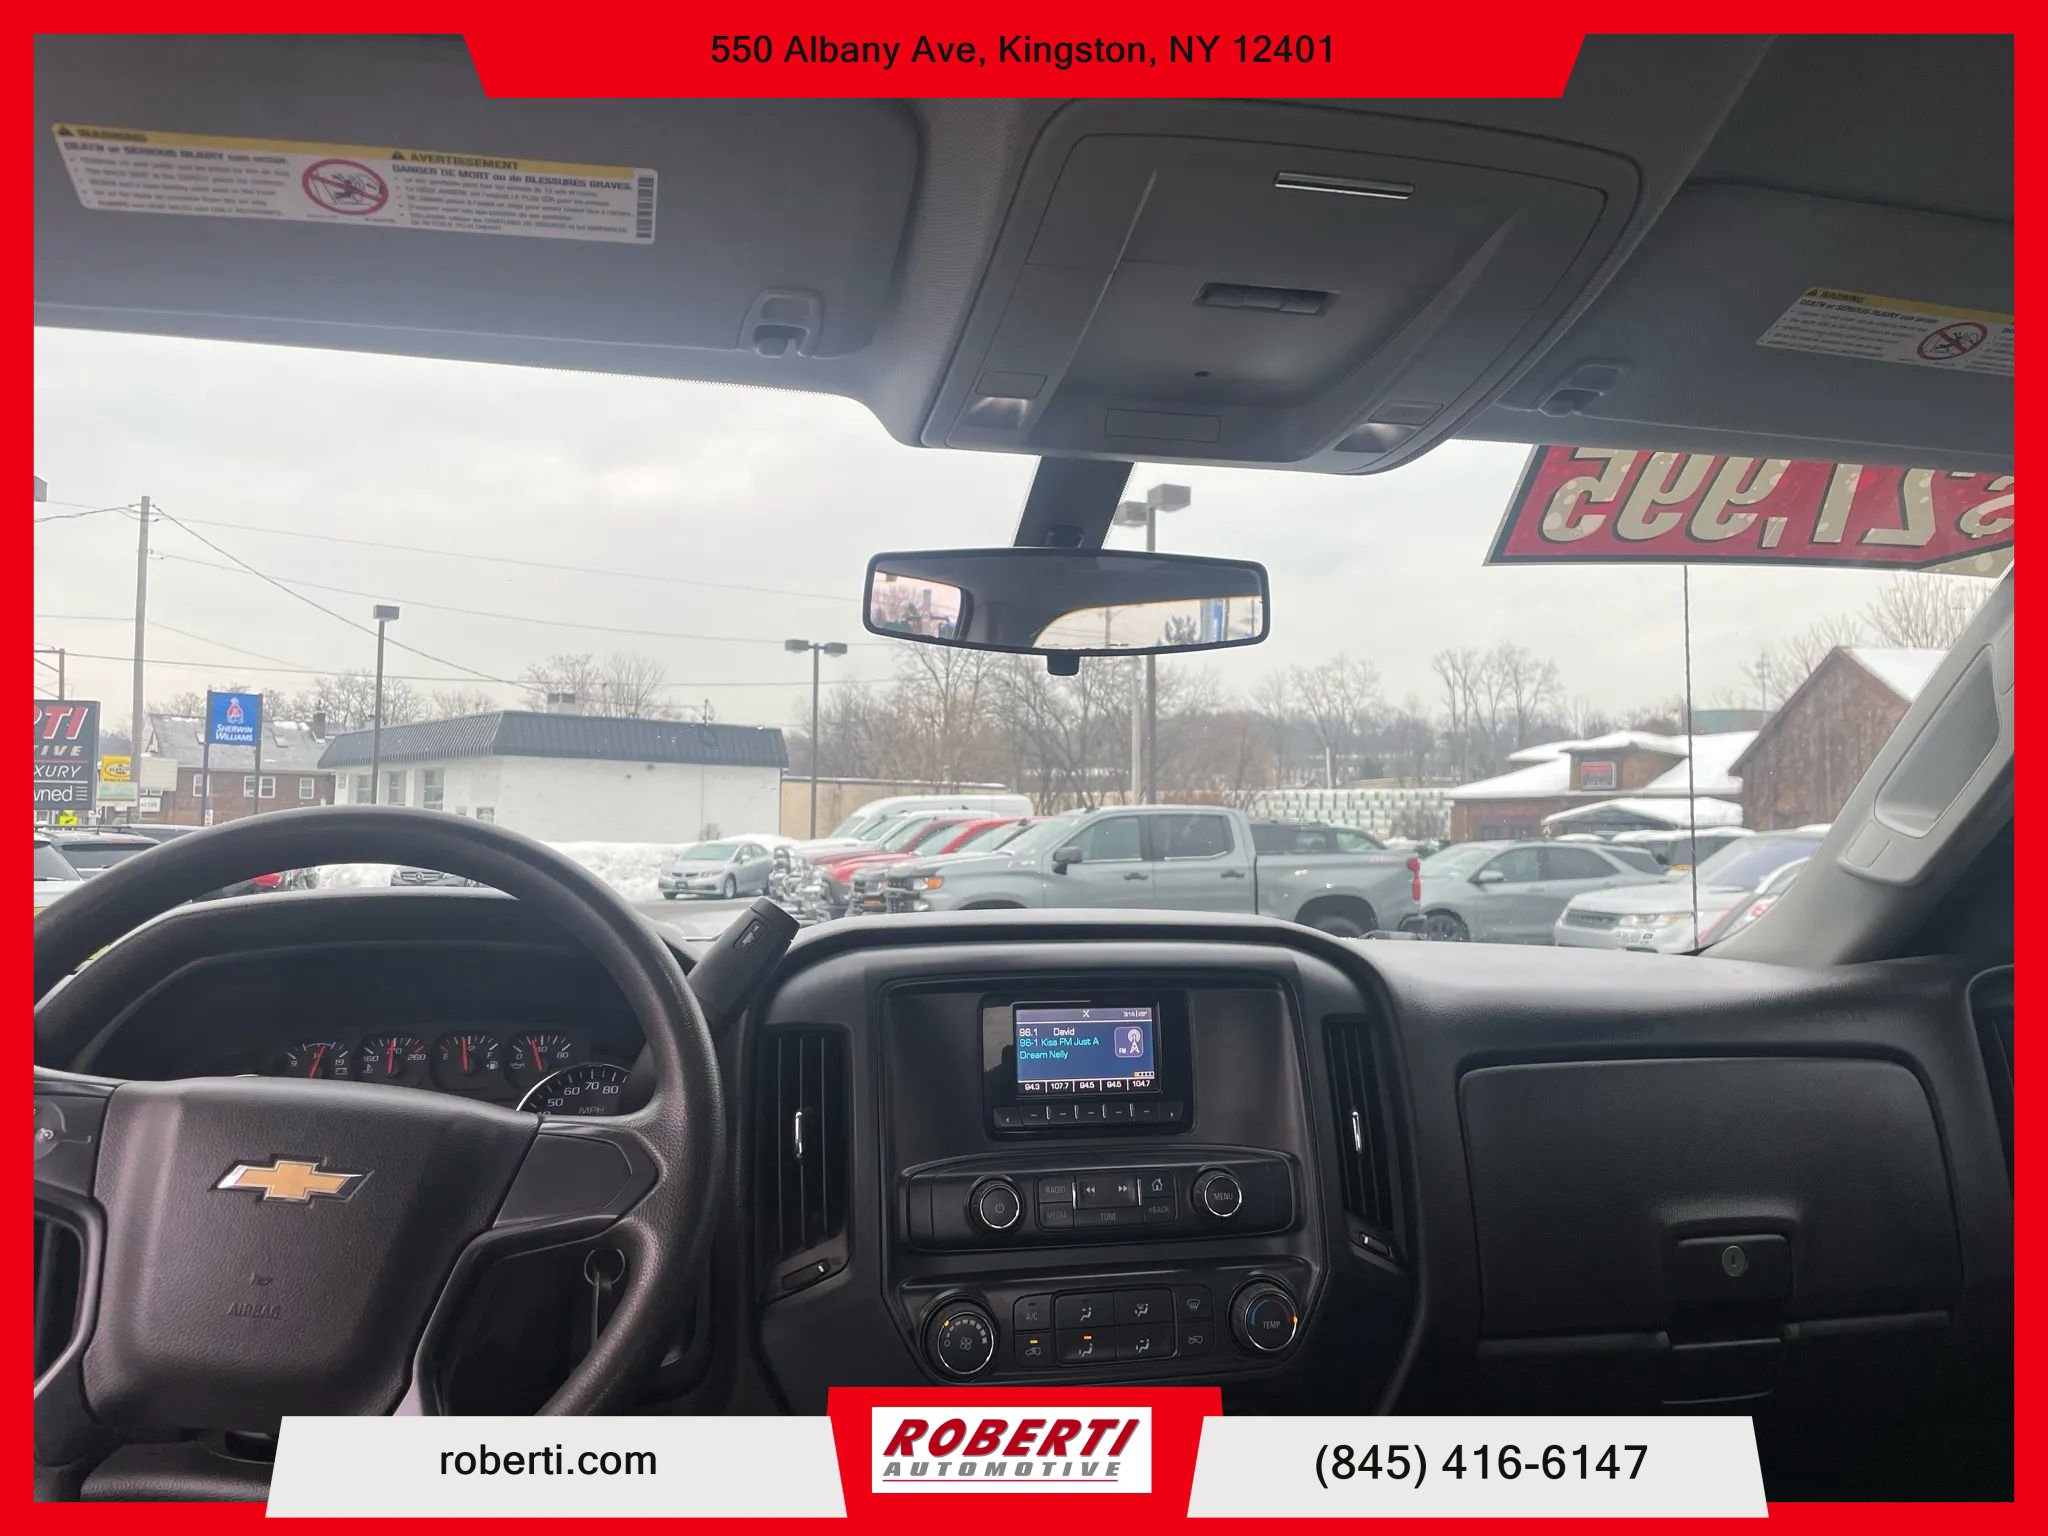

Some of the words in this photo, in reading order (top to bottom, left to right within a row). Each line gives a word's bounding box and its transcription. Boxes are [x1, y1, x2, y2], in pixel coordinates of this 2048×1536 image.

[216, 723, 253, 733] SHERWIN
[215, 731, 254, 742] WILLIAMS
[1053, 1027, 1075, 1036] David
[1041, 1037, 1058, 1047] Kiss
[1060, 1037, 1073, 1046] FM
[1074, 1037, 1091, 1046] Just
[1092, 1036, 1100, 1046] A
[362, 1055, 380, 1063] 160
[407, 1053, 426, 1062] 260
[1019, 1050, 1048, 1060] Dream
[1049, 1049, 1069, 1060] Nelly
[334, 1058, 345, 1067] 19
[585, 1082, 600, 1091] 70
[602, 1085, 619, 1095] 80
[1050, 1082, 1069, 1090] 107.7
[1132, 1080, 1151, 1088] 104.7
[563, 1087, 580, 1096] 60
[547, 1098, 564, 1108] 50
[578, 1107, 605, 1115] MPH
[1213, 1192, 1234, 1201] MENU
[225, 1301, 282, 1320] AIRBAG
[1025, 1311, 1039, 1322] A/C
[1262, 1320, 1281, 1330] TEMP
